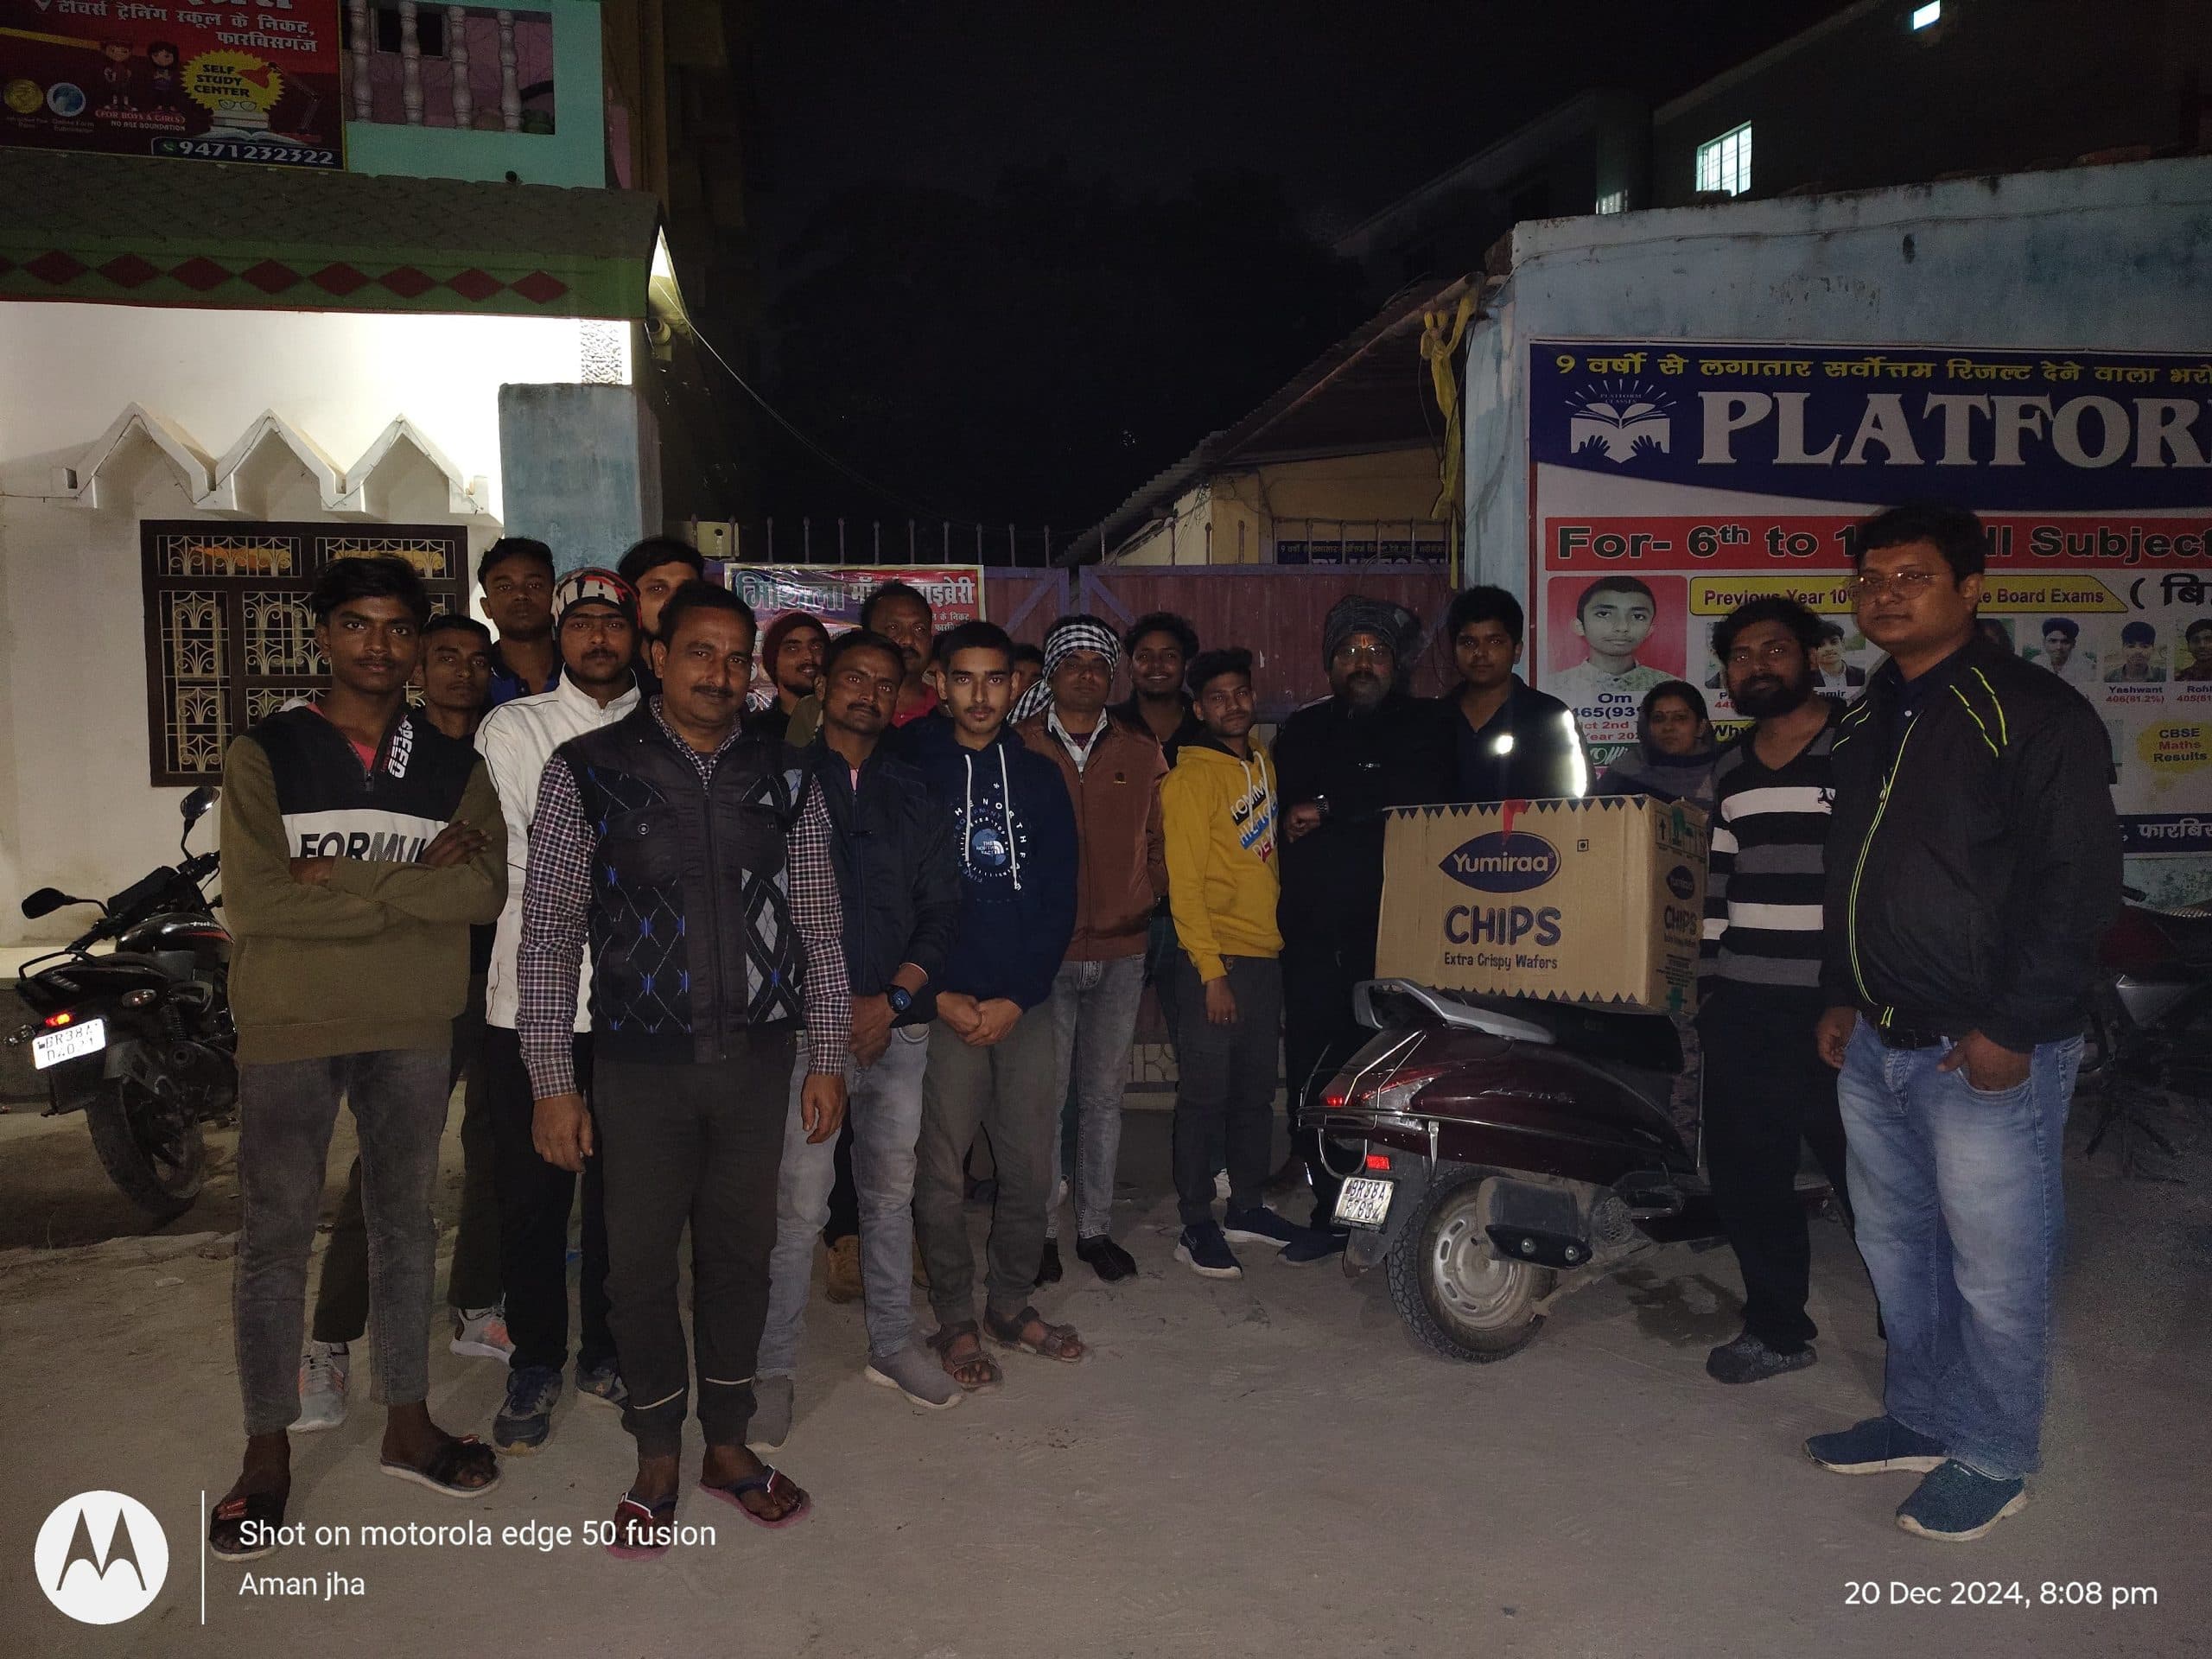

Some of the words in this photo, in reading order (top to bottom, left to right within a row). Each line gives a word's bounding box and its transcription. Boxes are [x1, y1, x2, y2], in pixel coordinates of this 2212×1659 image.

[230, 12, 250, 28] के
[203, 64, 236, 75] SELF
[196, 74, 243, 86] STUDY
[193, 85, 250, 98] CENTER
[178, 140, 335, 165] 9471232322
[1657, 353, 1689, 375] से
[1698, 359, 1814, 378] लगातार
[1946, 358, 2034, 381] रिजल्ट
[2040, 360, 2085, 382] देने
[2094, 365, 2161, 384] वाला
[1698, 388, 2212, 468] PLATFOR
[1687, 524, 1751, 559] 6th
[1764, 524, 1820, 558] to
[1785, 589, 1825, 606] Year
[1997, 588, 2045, 603] Board
[2050, 588, 2104, 603] Exams
[1598, 693, 1633, 704] Om
[2159, 728, 2202, 739] CBSE
[2158, 740, 2202, 751] Maths
[2153, 751, 2208, 763] Results
[1452, 851, 1550, 873] Yumiraa
[1443, 905, 1563, 947] CHIPS
[1444, 951, 1475, 967] Extra
[1477, 952, 1512, 971] Crispy
